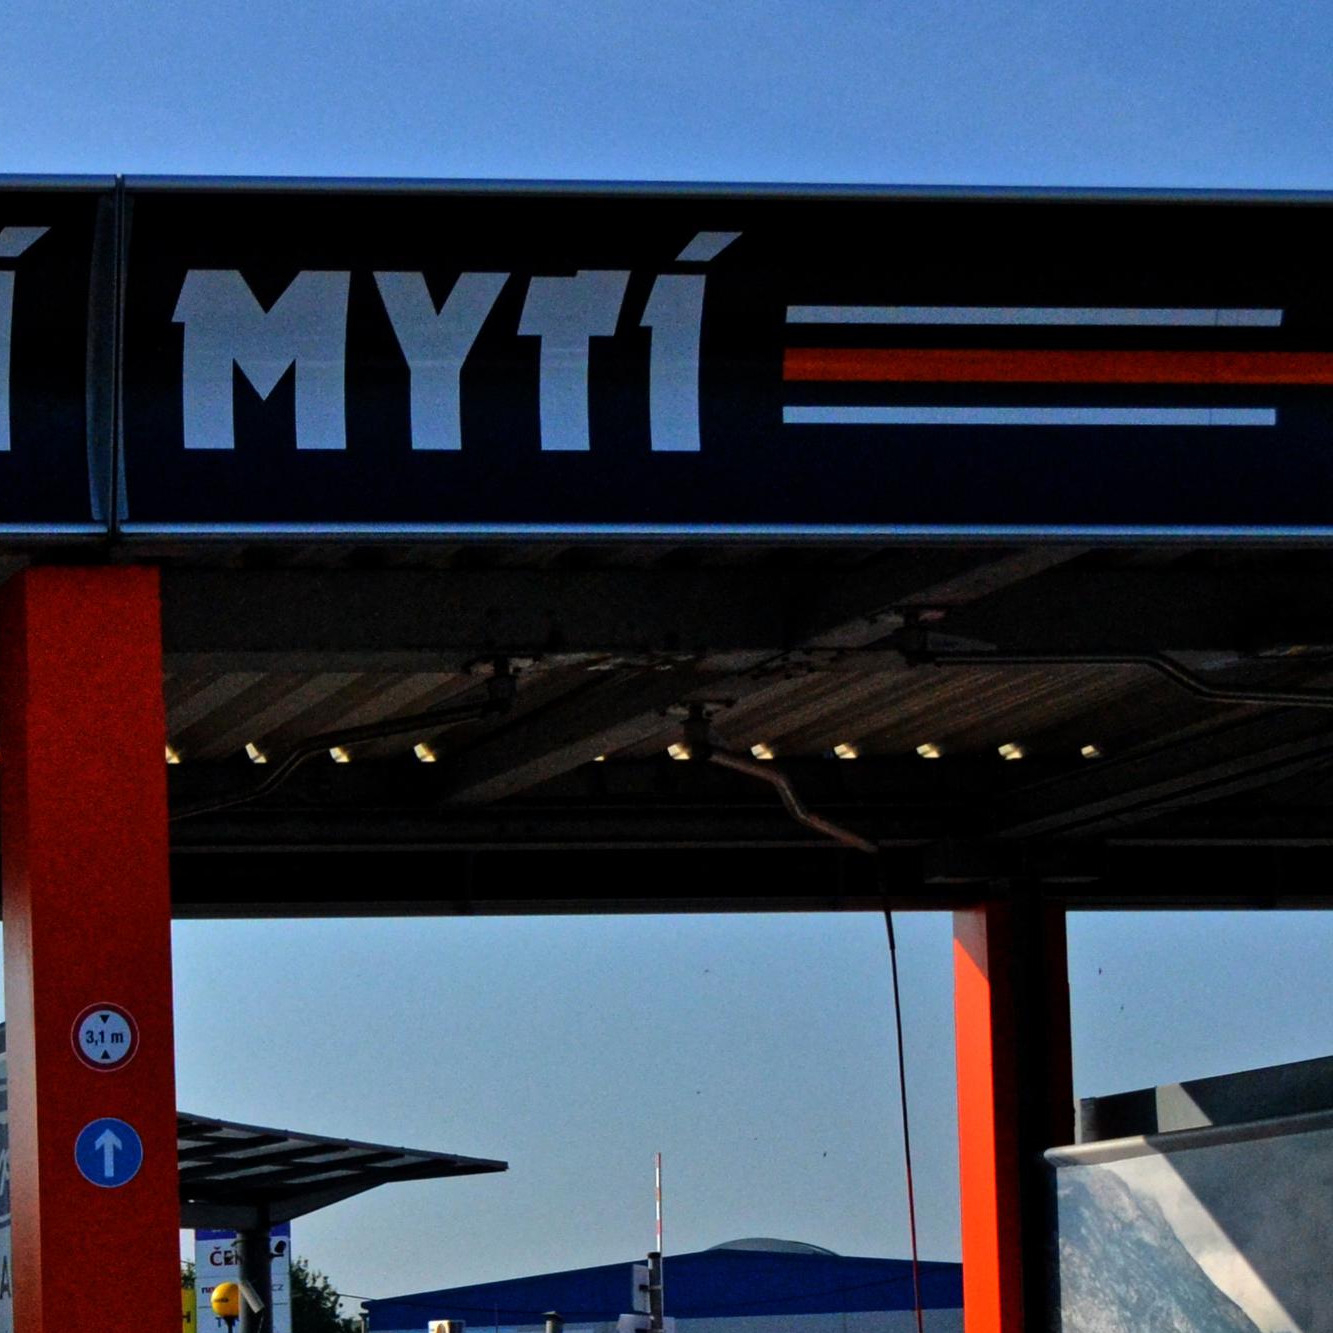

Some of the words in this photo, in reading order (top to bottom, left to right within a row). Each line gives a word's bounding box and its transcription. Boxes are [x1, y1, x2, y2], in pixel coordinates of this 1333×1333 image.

[171, 231, 743, 452] MYTÍ
[85, 1030, 105, 1046] 3,1
[110, 1032, 124, 1044] m
